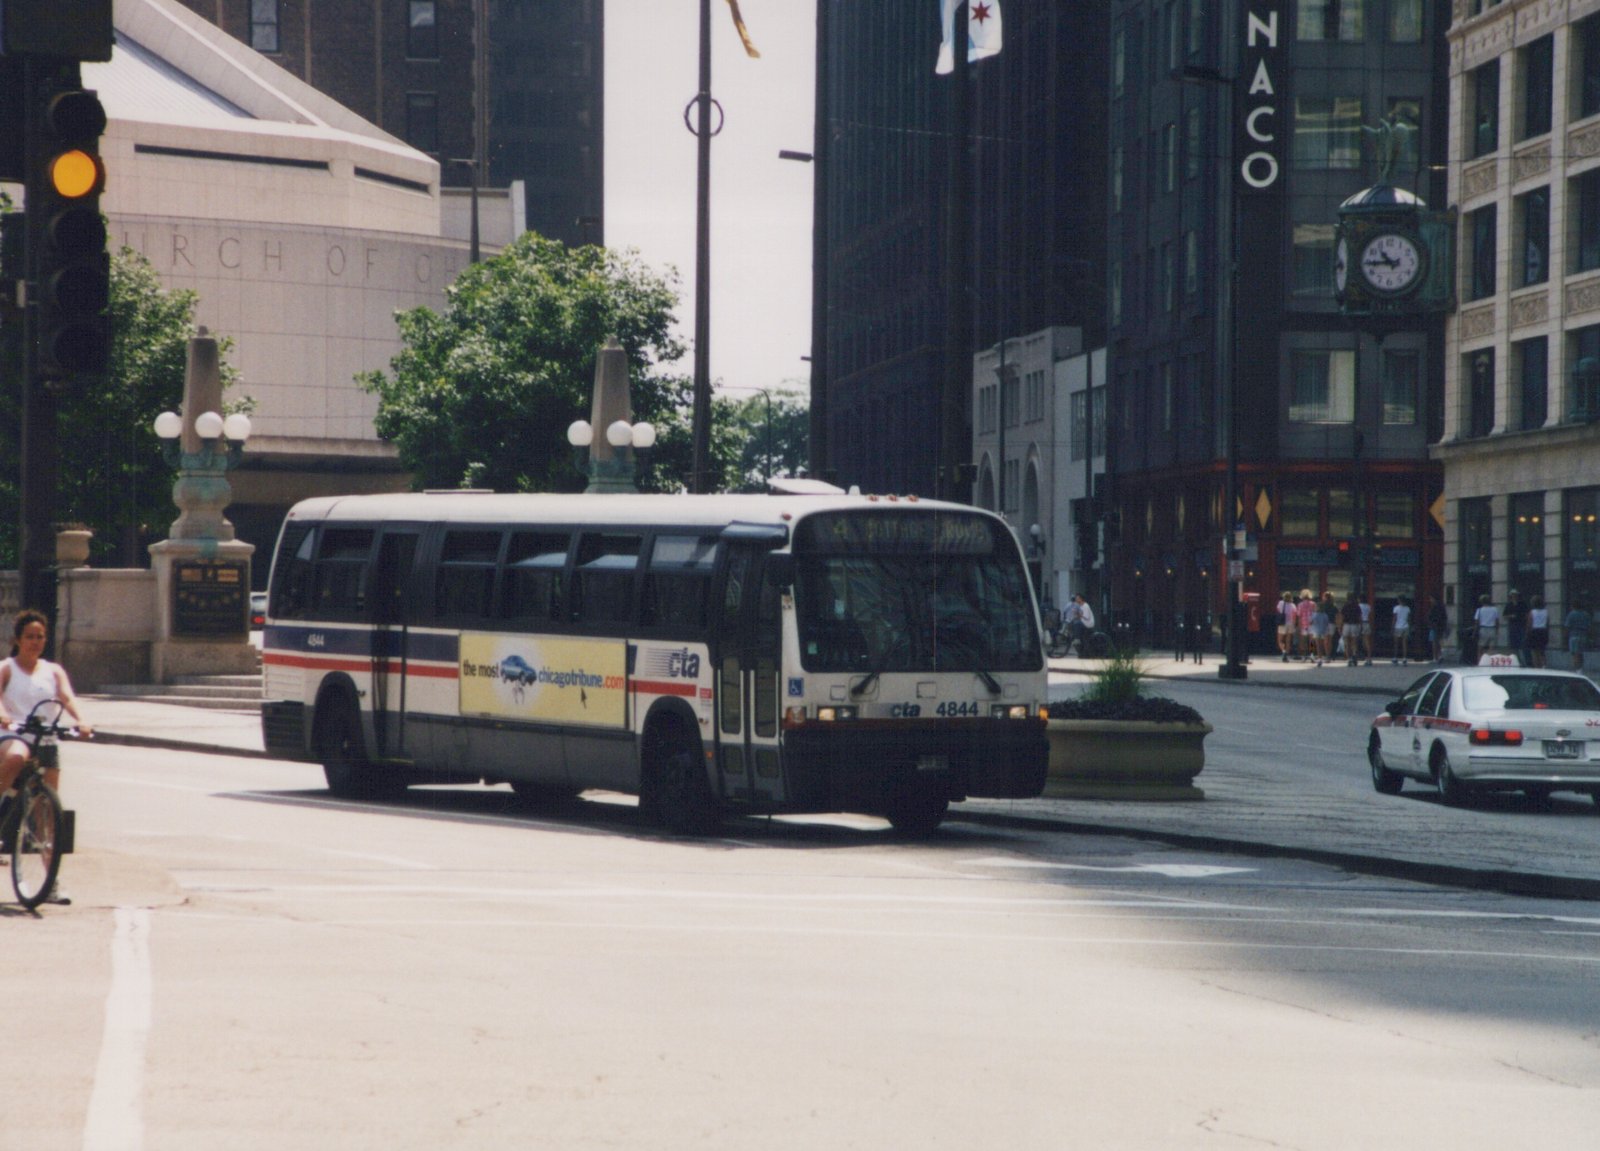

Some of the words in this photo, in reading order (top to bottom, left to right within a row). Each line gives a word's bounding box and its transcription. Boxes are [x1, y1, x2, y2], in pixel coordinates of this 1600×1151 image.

[325, 245, 376, 279] OF
[307, 633, 324, 647] 4844
[669, 646, 700, 678] cta
[1491, 657, 1512, 666] 3299
[463, 659, 477, 676] the
[478, 662, 500, 678] most
[538, 666, 624, 689] chicagotribune.com
[891, 701, 921, 717] cta
[936, 701, 979, 717] 4844
